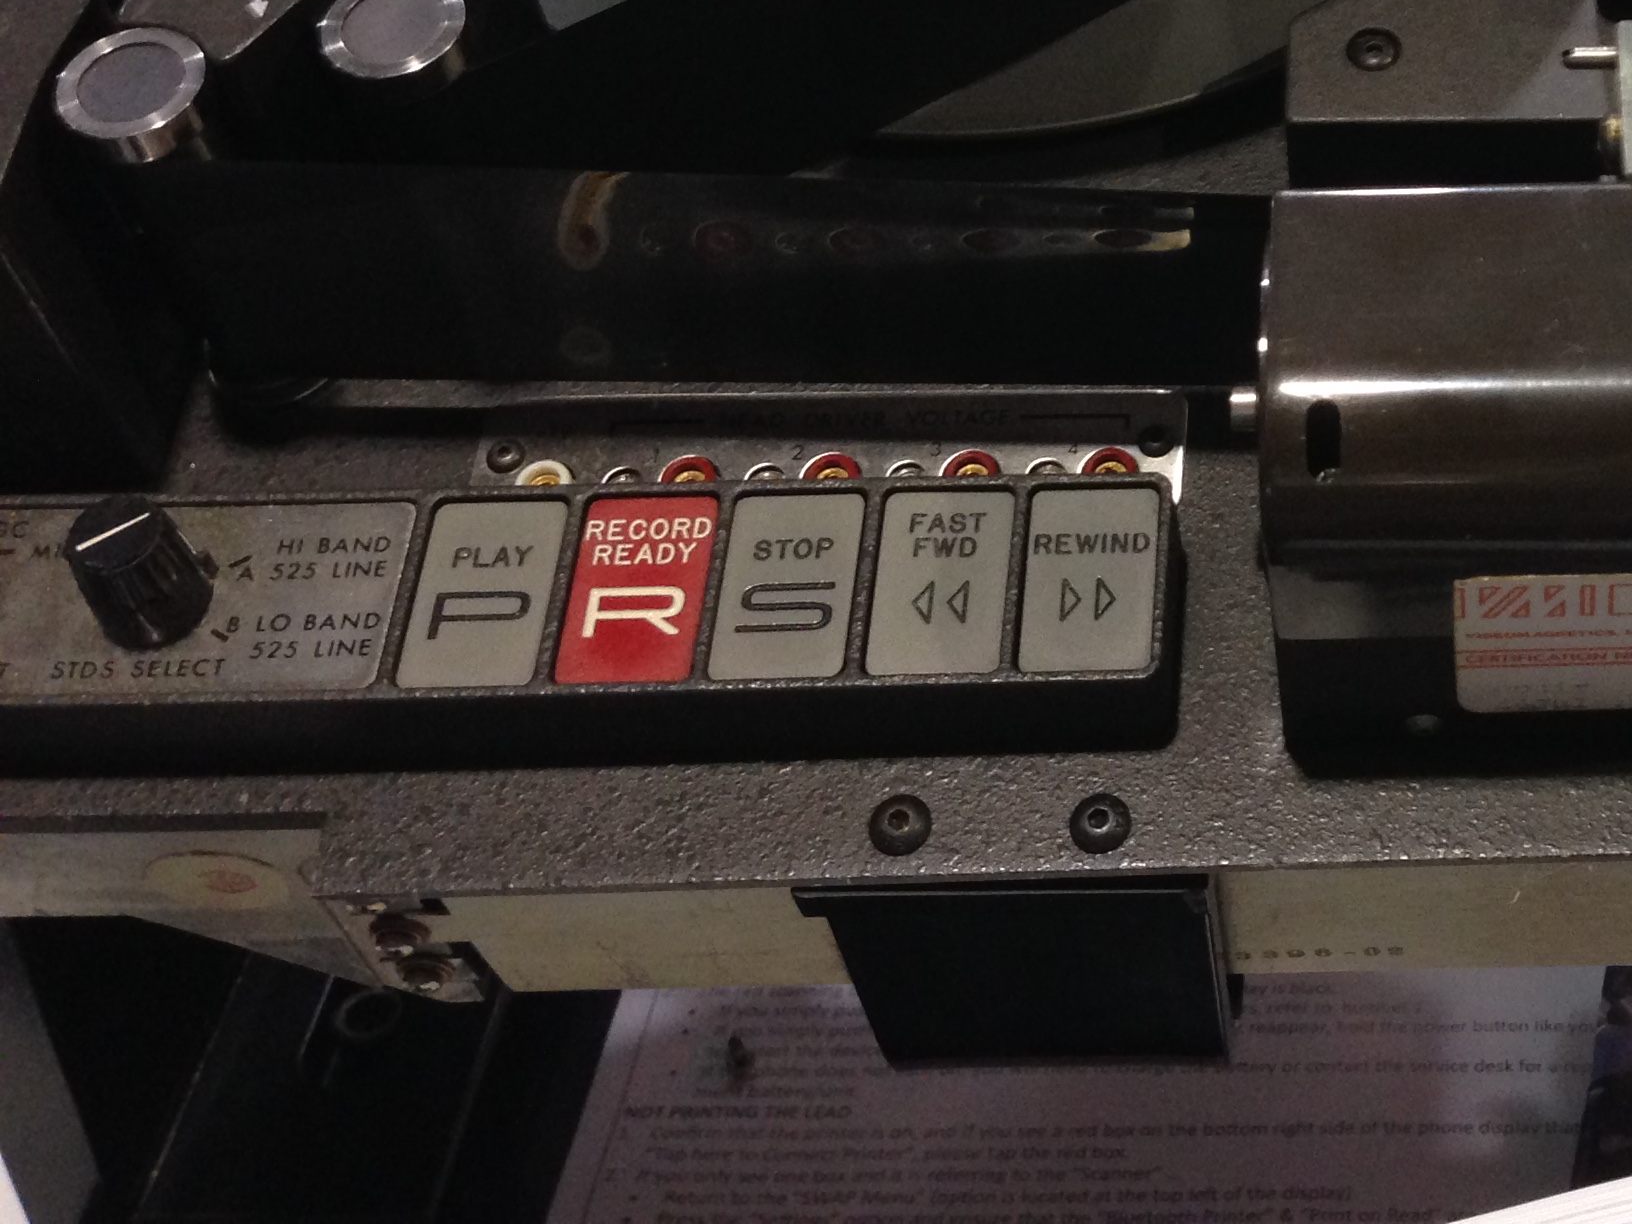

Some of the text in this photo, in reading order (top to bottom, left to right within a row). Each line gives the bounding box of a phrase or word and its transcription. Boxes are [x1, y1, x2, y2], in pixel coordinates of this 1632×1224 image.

[907, 408, 1010, 427] VOLTAGE
[793, 444, 806, 461] 2
[932, 440, 944, 457] 3
[584, 516, 713, 542] RECORD
[909, 512, 987, 534] FAST
[277, 536, 391, 554] HI BAND
[591, 541, 697, 566] READY
[753, 537, 835, 562] STOP
[913, 536, 977, 559] FWD
[1033, 532, 1151, 555] REWIND
[451, 544, 535, 569] PLAY
[236, 560, 388, 582] A 525 LINE
[427, 590, 531, 640] P
[582, 585, 688, 639] R
[734, 581, 836, 634] S
[227, 612, 381, 633] B LO BAND
[249, 639, 372, 659] 525 LINE
[1465, 651, 1609, 665] CERTIFICATION
[51, 658, 226, 679] STDS SELECT
[1471, 1019, 1530, 1033] button
[1473, 1058, 1513, 1073] desk
[1518, 1057, 1542, 1072] for
[1202, 1122, 1268, 1137] bottom
[1319, 1120, 1354, 1135] side
[1359, 1120, 1379, 1135] of
[1382, 1121, 1413, 1135] the
[1417, 1120, 1475, 1137] phone
[1477, 1119, 1542, 1137] display
[1153, 1187, 1183, 1204] top
[1246, 1187, 1276, 1202] the
